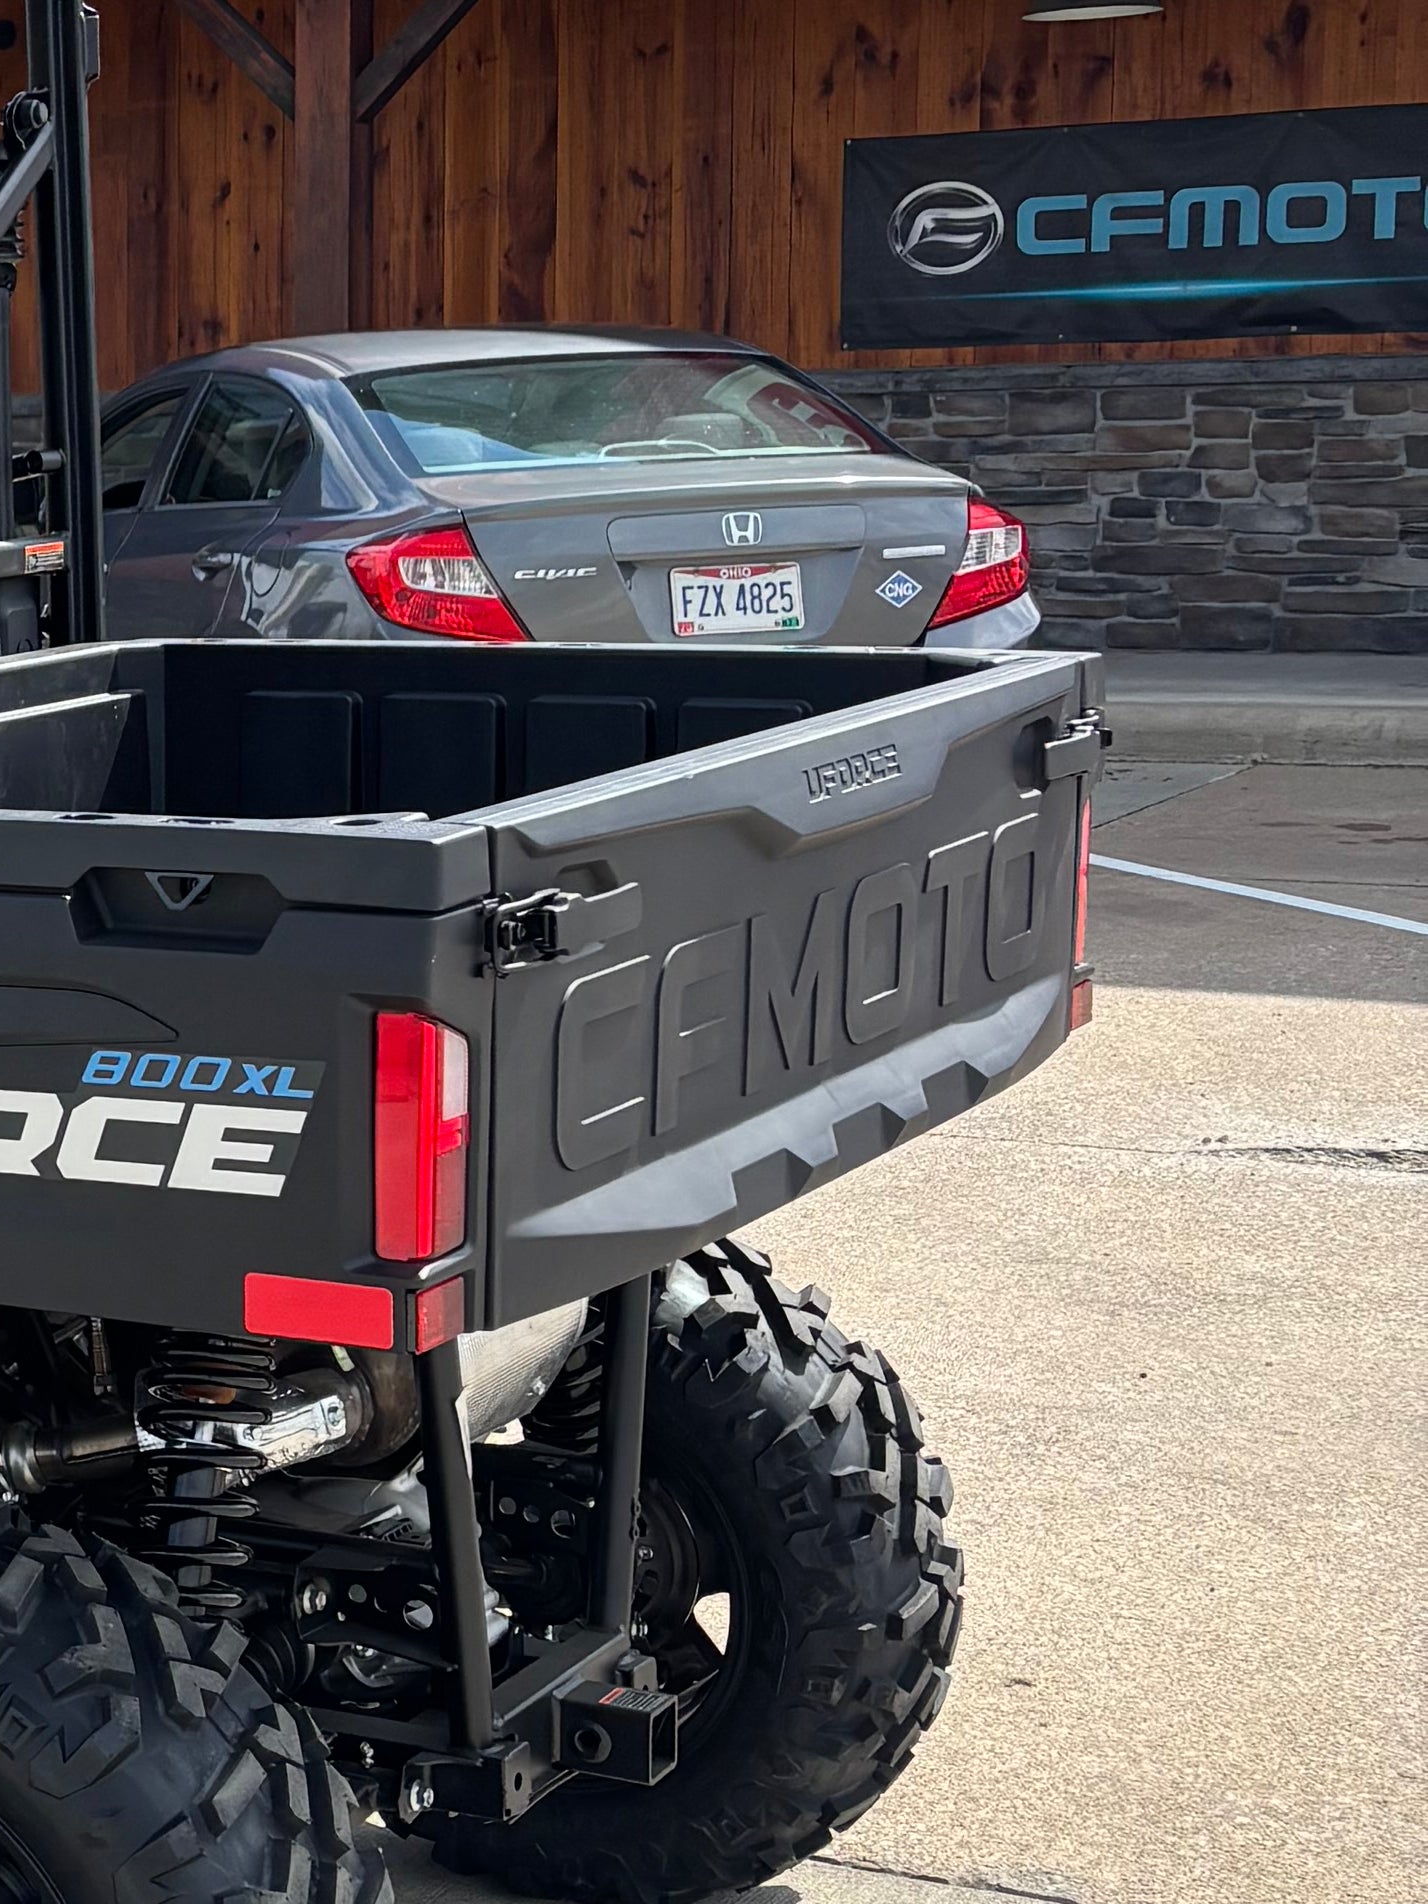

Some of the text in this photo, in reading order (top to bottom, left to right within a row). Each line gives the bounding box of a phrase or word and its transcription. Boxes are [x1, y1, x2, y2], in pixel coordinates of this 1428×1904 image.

[1016, 176, 1428, 256] CFMOT
[514, 567, 597, 580] CIVIC
[720, 566, 752, 579] OHIO
[885, 581, 913, 597] CNG
[681, 580, 794, 618] FZX 4825
[802, 743, 902, 804] UFORCE
[556, 812, 1040, 1172] CFMOTO
